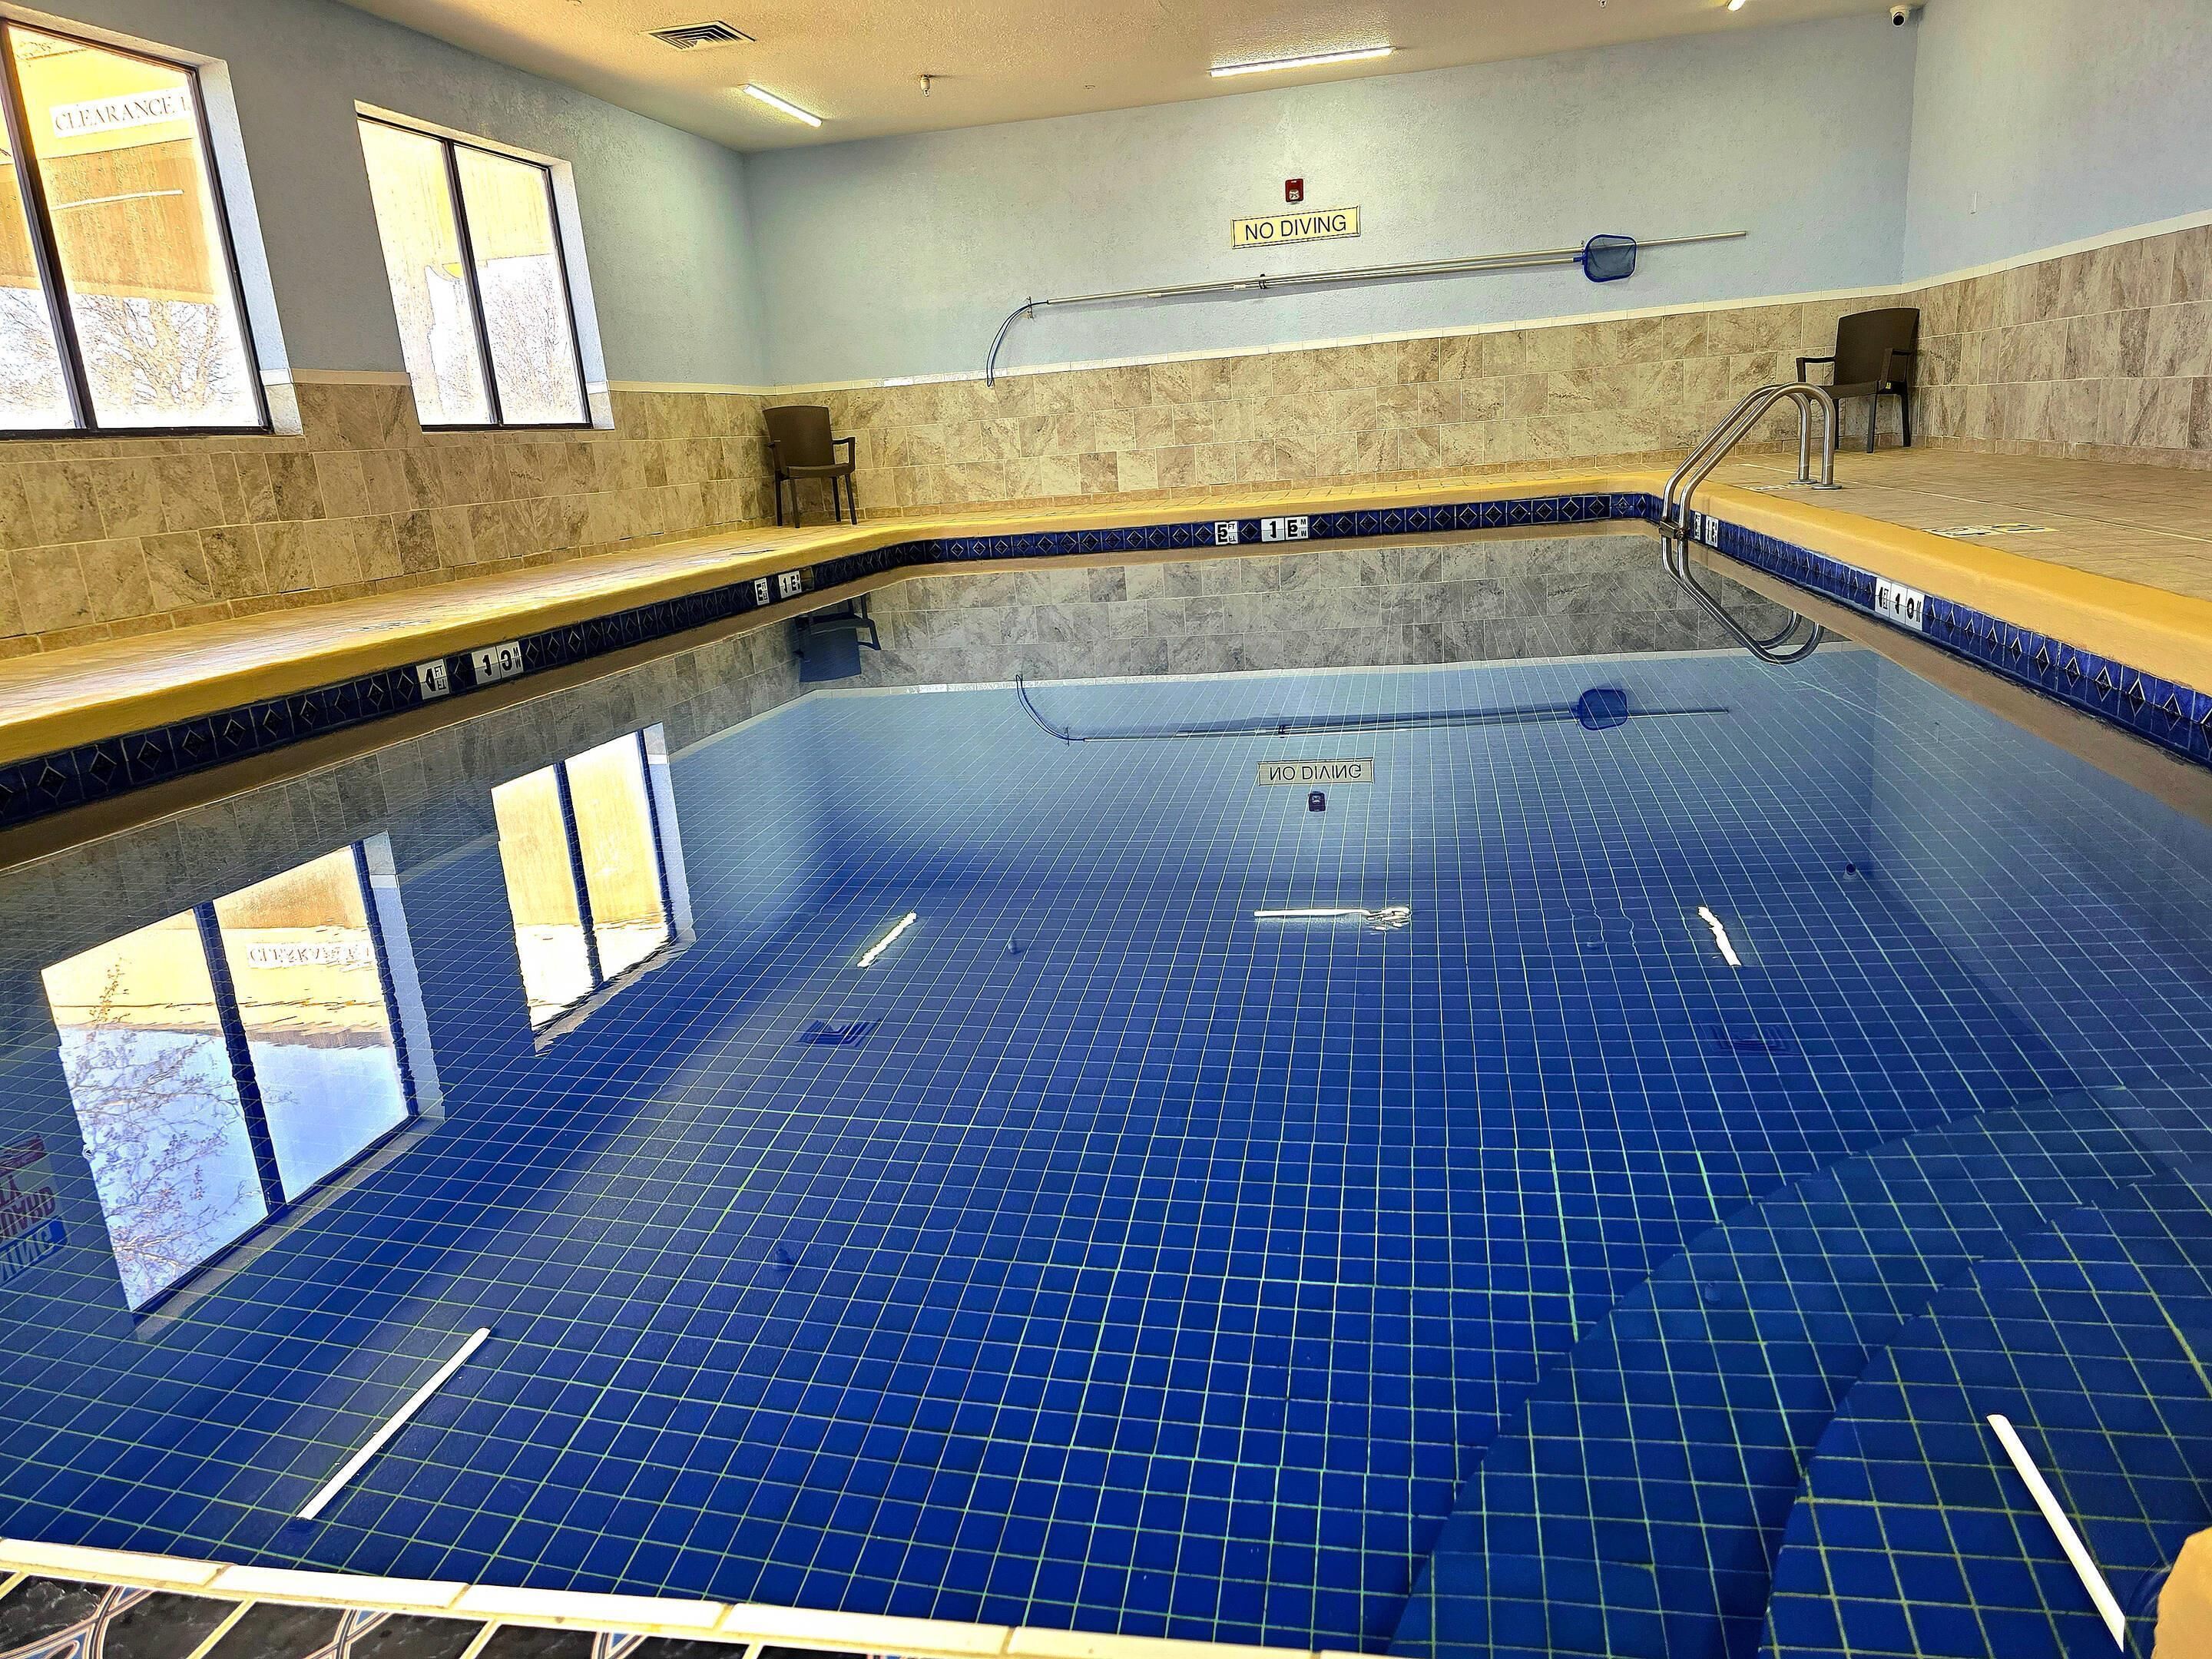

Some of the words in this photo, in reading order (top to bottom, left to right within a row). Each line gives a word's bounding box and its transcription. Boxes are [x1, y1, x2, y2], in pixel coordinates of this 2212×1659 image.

[55, 96, 175, 131] CLEARANCE
[1245, 222, 1273, 240] NO
[1280, 214, 1346, 237] DIVING
